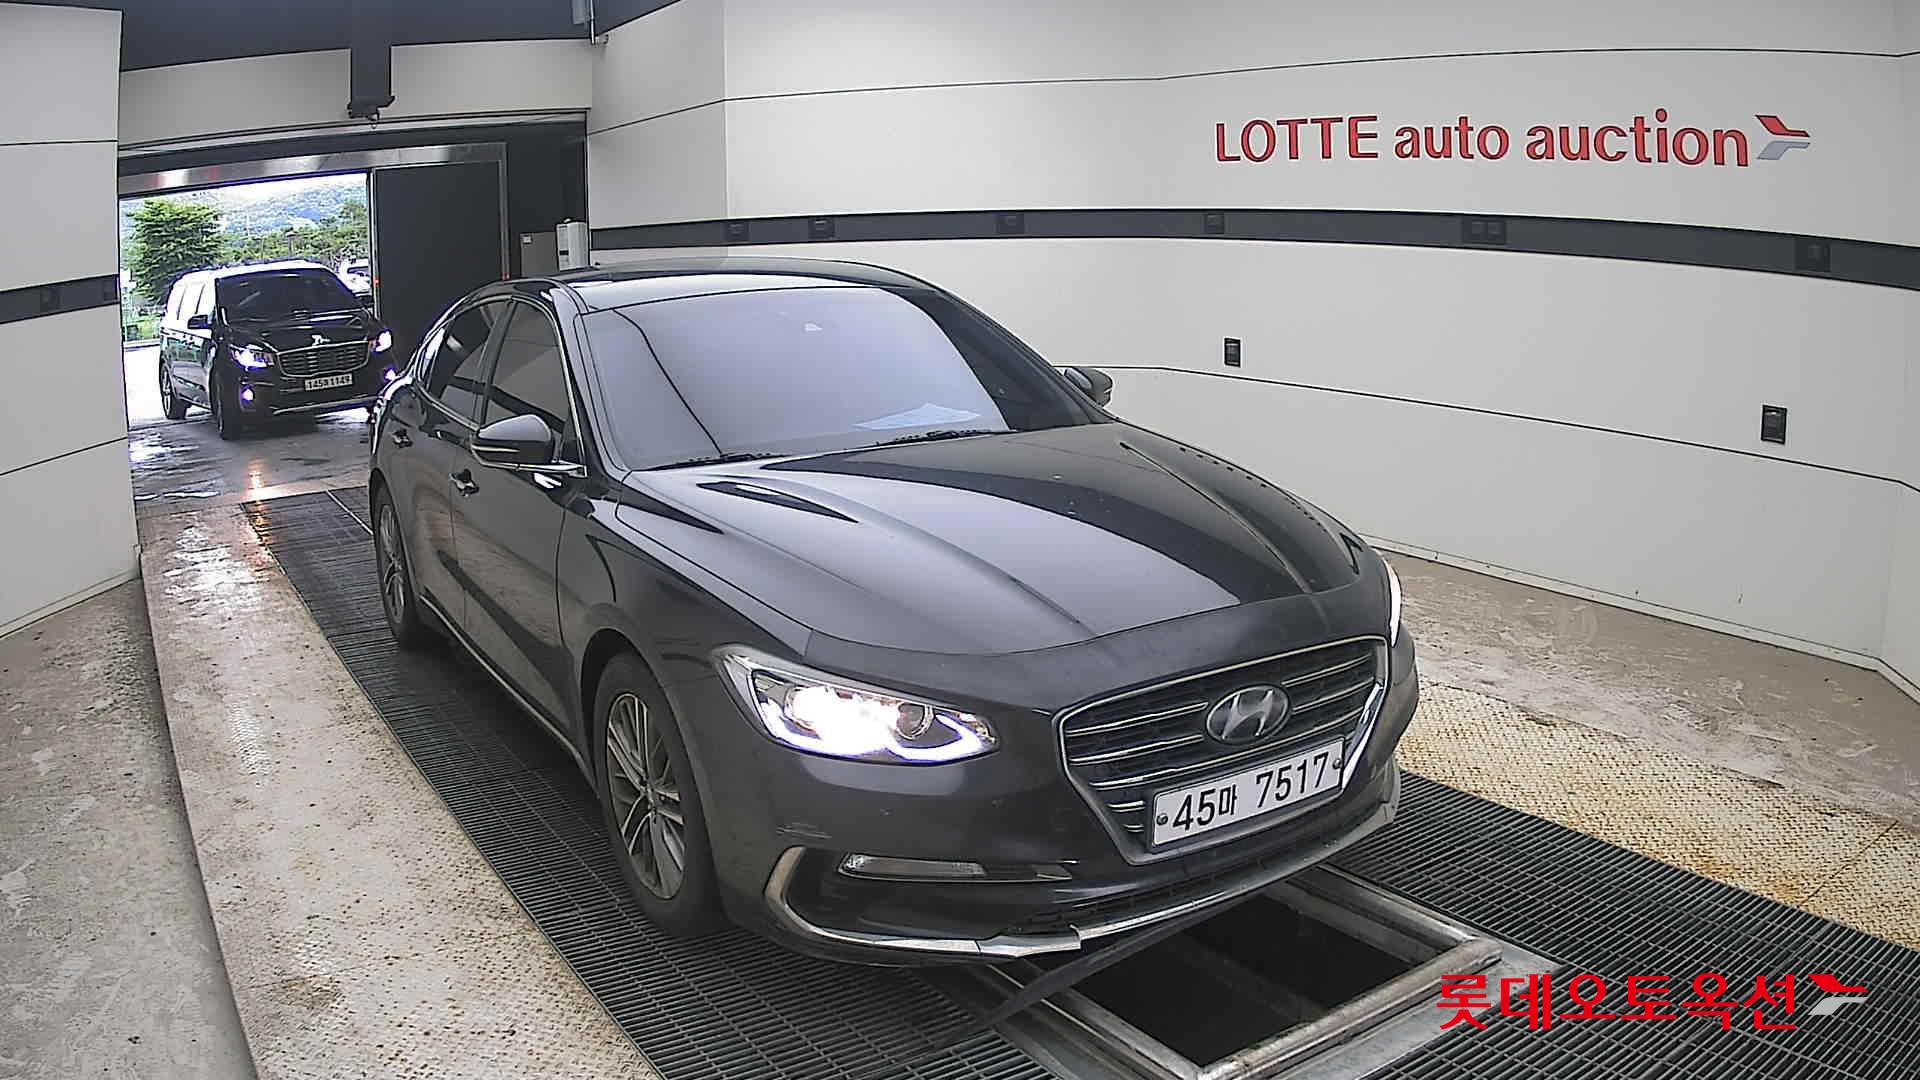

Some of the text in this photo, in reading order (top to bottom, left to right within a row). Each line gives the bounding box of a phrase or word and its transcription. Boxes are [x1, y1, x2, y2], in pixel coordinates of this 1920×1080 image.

[1216, 108, 1749, 167] LOTTE auto auction
[1172, 752, 1329, 831] 45마 7517
